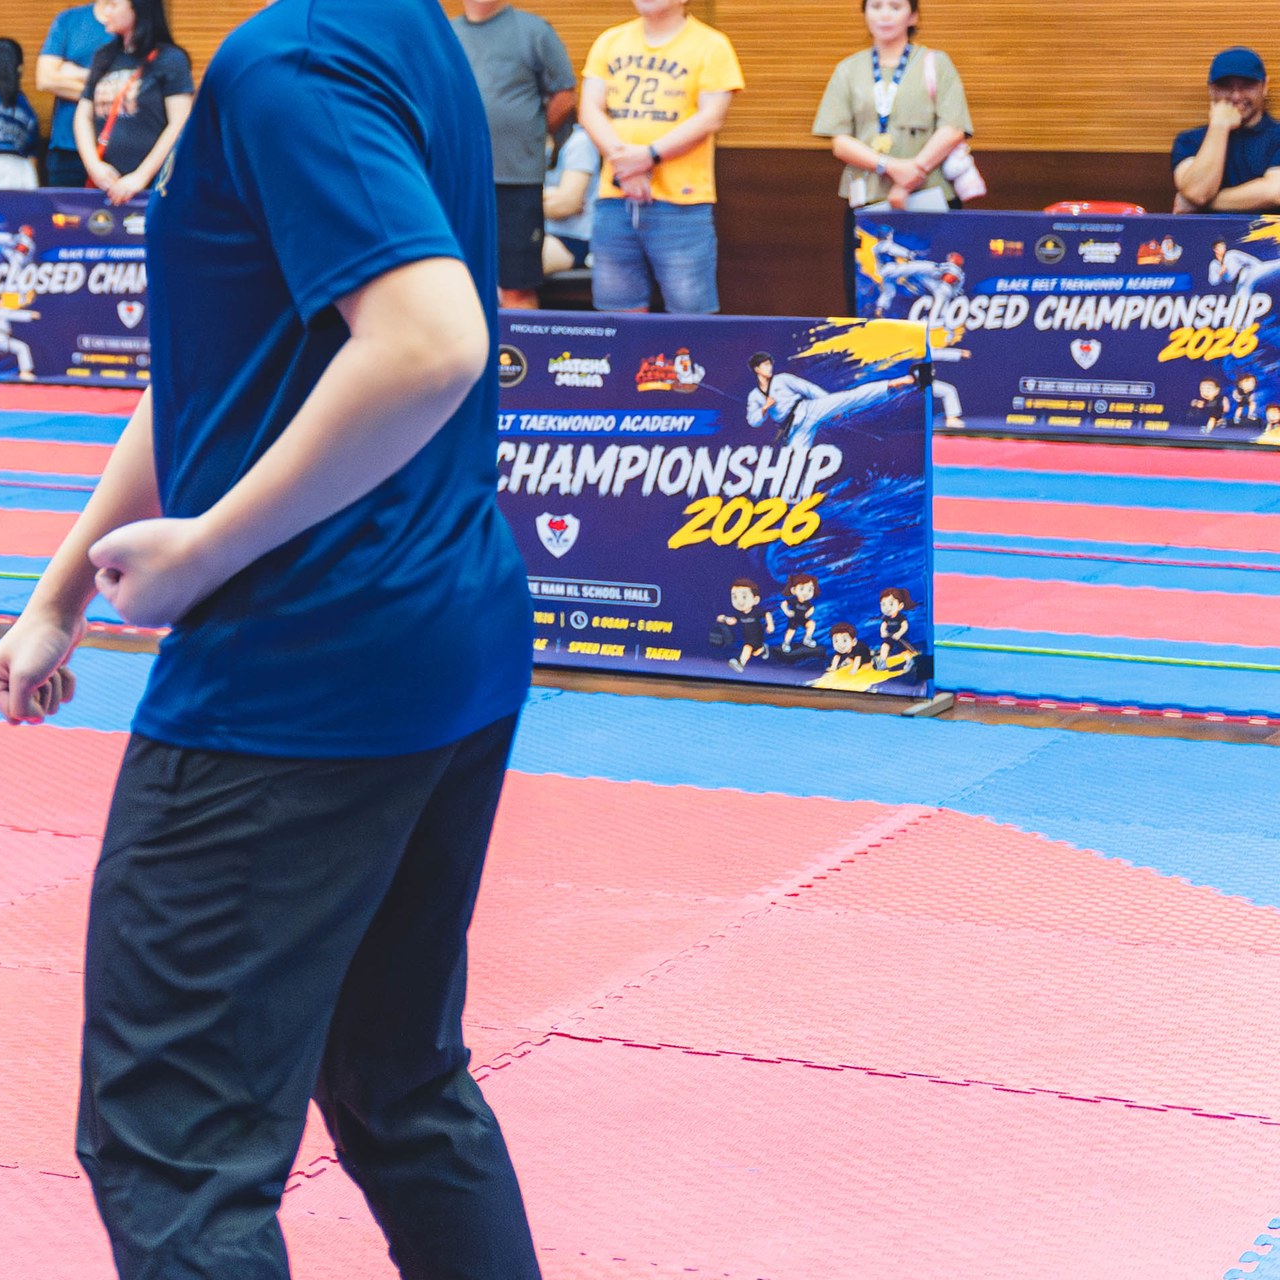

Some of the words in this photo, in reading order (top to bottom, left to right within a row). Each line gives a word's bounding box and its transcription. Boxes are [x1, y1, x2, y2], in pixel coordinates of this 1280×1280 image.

[624, 74, 659, 105] 72
[908, 294, 1029, 331] CLOSED
[1034, 292, 1272, 334] CHAMPIONSHIP
[1157, 322, 1260, 363] 2026
[519, 414, 616, 432] TAEKWONDO
[619, 415, 695, 432] ACADEMY
[667, 491, 827, 550] 2026
[582, 585, 622, 600] SCHOOL
[624, 588, 651, 602] HALL
